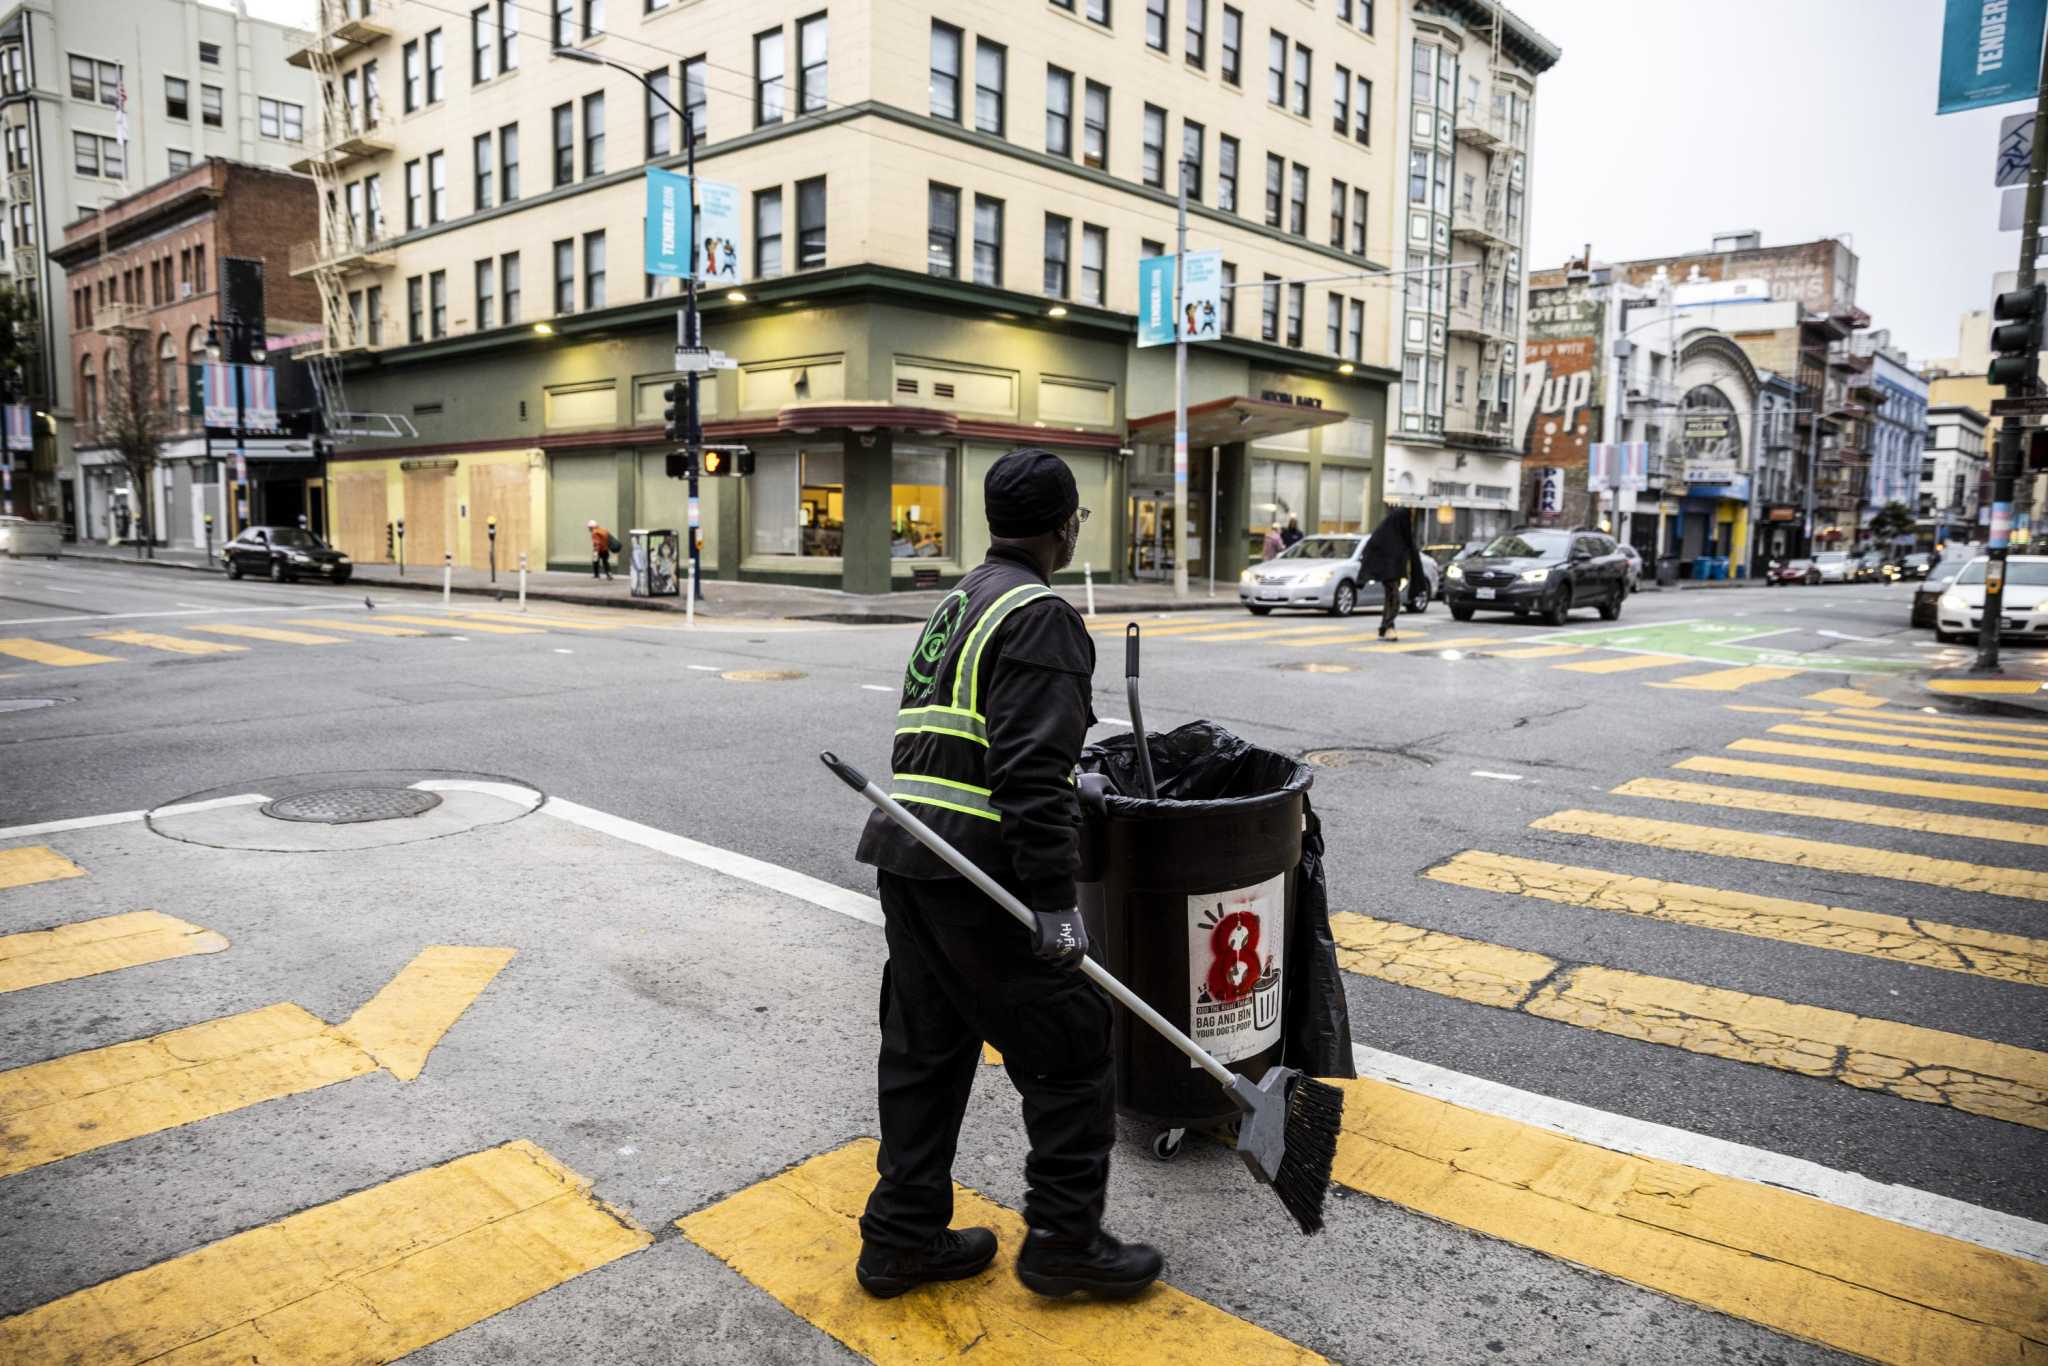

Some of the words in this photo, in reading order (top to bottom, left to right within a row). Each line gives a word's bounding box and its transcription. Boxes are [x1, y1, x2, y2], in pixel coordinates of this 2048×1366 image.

[1527, 305, 1584, 322] OTEL
[1542, 467, 1556, 511] PARK
[1196, 1016, 1215, 1029] BAG
[1217, 1012, 1236, 1026] AND
[1238, 1008, 1252, 1022] BIN
[1196, 1028, 1215, 1038] YOUR
[1216, 1025, 1236, 1036] DOG'S
[1236, 1020, 1252, 1033] POOP
